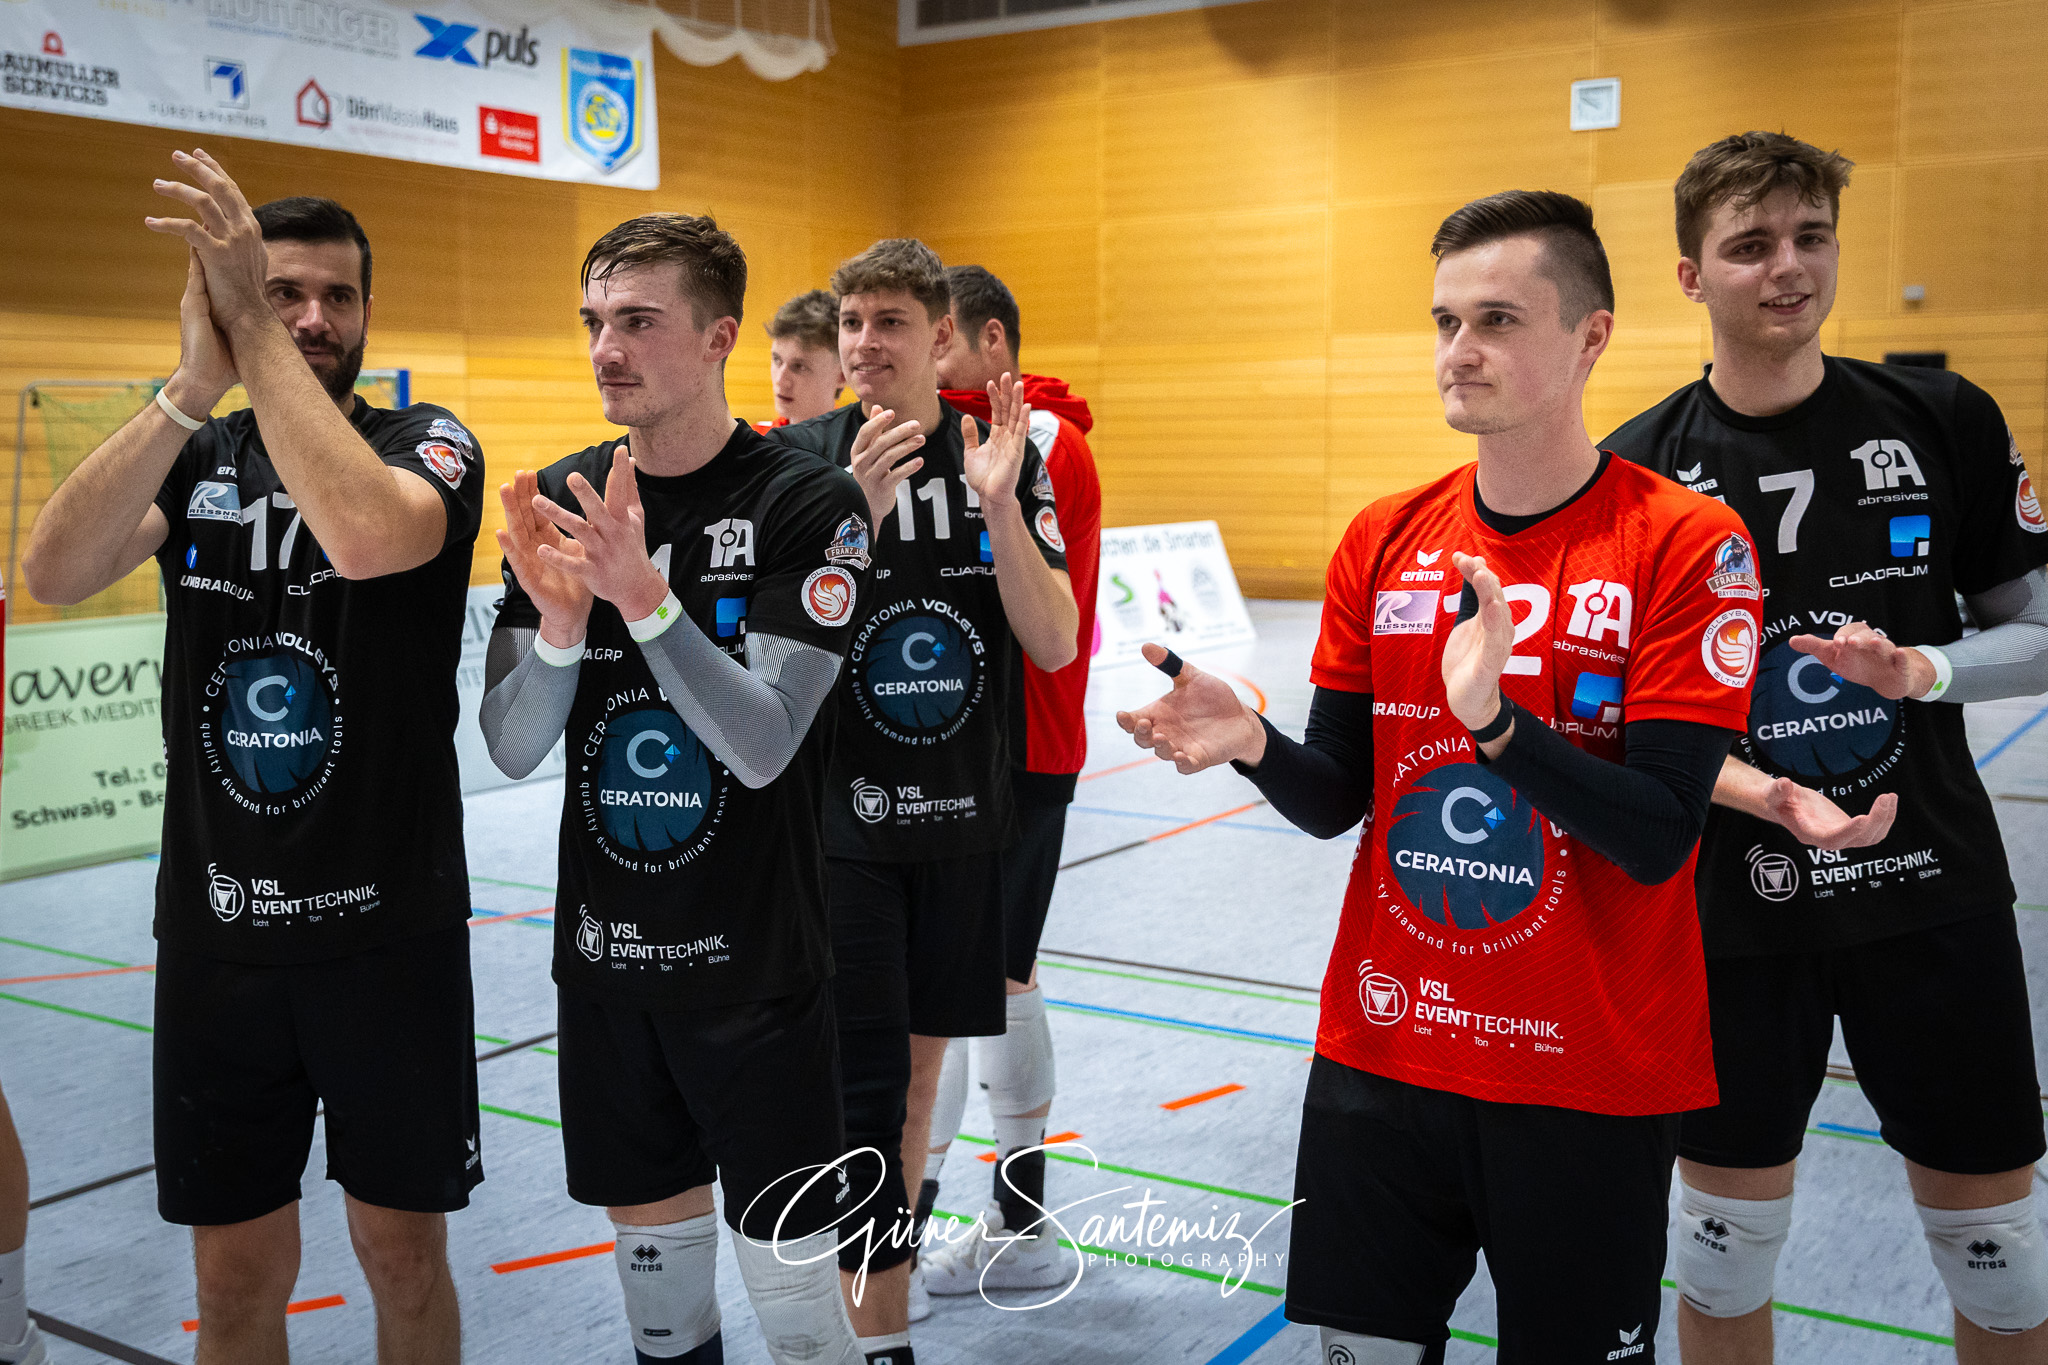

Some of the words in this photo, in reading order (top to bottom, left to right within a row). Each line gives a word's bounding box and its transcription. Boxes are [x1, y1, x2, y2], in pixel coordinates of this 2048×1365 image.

[3, 73, 107, 106] SERVICES
[895, 477, 951, 541] 11
[1857, 492, 1929, 506] abrasives
[1758, 469, 1815, 554] 7
[700, 572, 754, 583] abrasives
[1401, 569, 1444, 582] erima
[1714, 573, 1741, 587] FRANZ
[1829, 564, 1928, 588] CUADRUM
[851, 599, 916, 662] CERATONIA
[921, 598, 985, 656] VOLLEYS
[1375, 622, 1432, 630] RIESSNER
[1553, 640, 1626, 664] abrasives
[874, 678, 964, 696] CERATONIA
[874, 720, 918, 745] diamond
[922, 735, 937, 745] for
[941, 706, 972, 741] brilliant
[972, 674, 985, 704] tools
[1757, 707, 1889, 740] CERATONIA
[227, 727, 324, 748] CERATONIA
[221, 777, 260, 814] diamond
[266, 804, 286, 816] for
[292, 761, 335, 809] brilliant
[331, 715, 344, 755] tools
[1832, 784, 1853, 797] for
[1858, 741, 1905, 788] brilliant
[600, 789, 702, 808] CERATONIA
[896, 786, 924, 799] VSL
[11, 797, 116, 830] Schwaig
[597, 836, 638, 871] diamond
[645, 862, 662, 873] for
[669, 830, 715, 870] brilliant
[1807, 849, 1848, 865] VSL
[1395, 850, 1534, 886] CERATONIA
[252, 879, 285, 896] VSL
[1814, 889, 1834, 898] Licht
[1868, 880, 1882, 888] Ton
[253, 919, 269, 927] Licht
[308, 914, 322, 923] Ton
[1389, 904, 1444, 949] diamond
[1452, 942, 1474, 955] for
[1482, 915, 1547, 954] brilliant
[1545, 870, 1566, 912] tools
[610, 922, 642, 939] VSL
[612, 962, 627, 970] Licht
[659, 963, 673, 971] Ton
[1419, 977, 1455, 1001] VSL
[1414, 1024, 1432, 1036] Licht
[1473, 1036, 1489, 1047] Ton
[1606, 1341, 1645, 1361] erima
